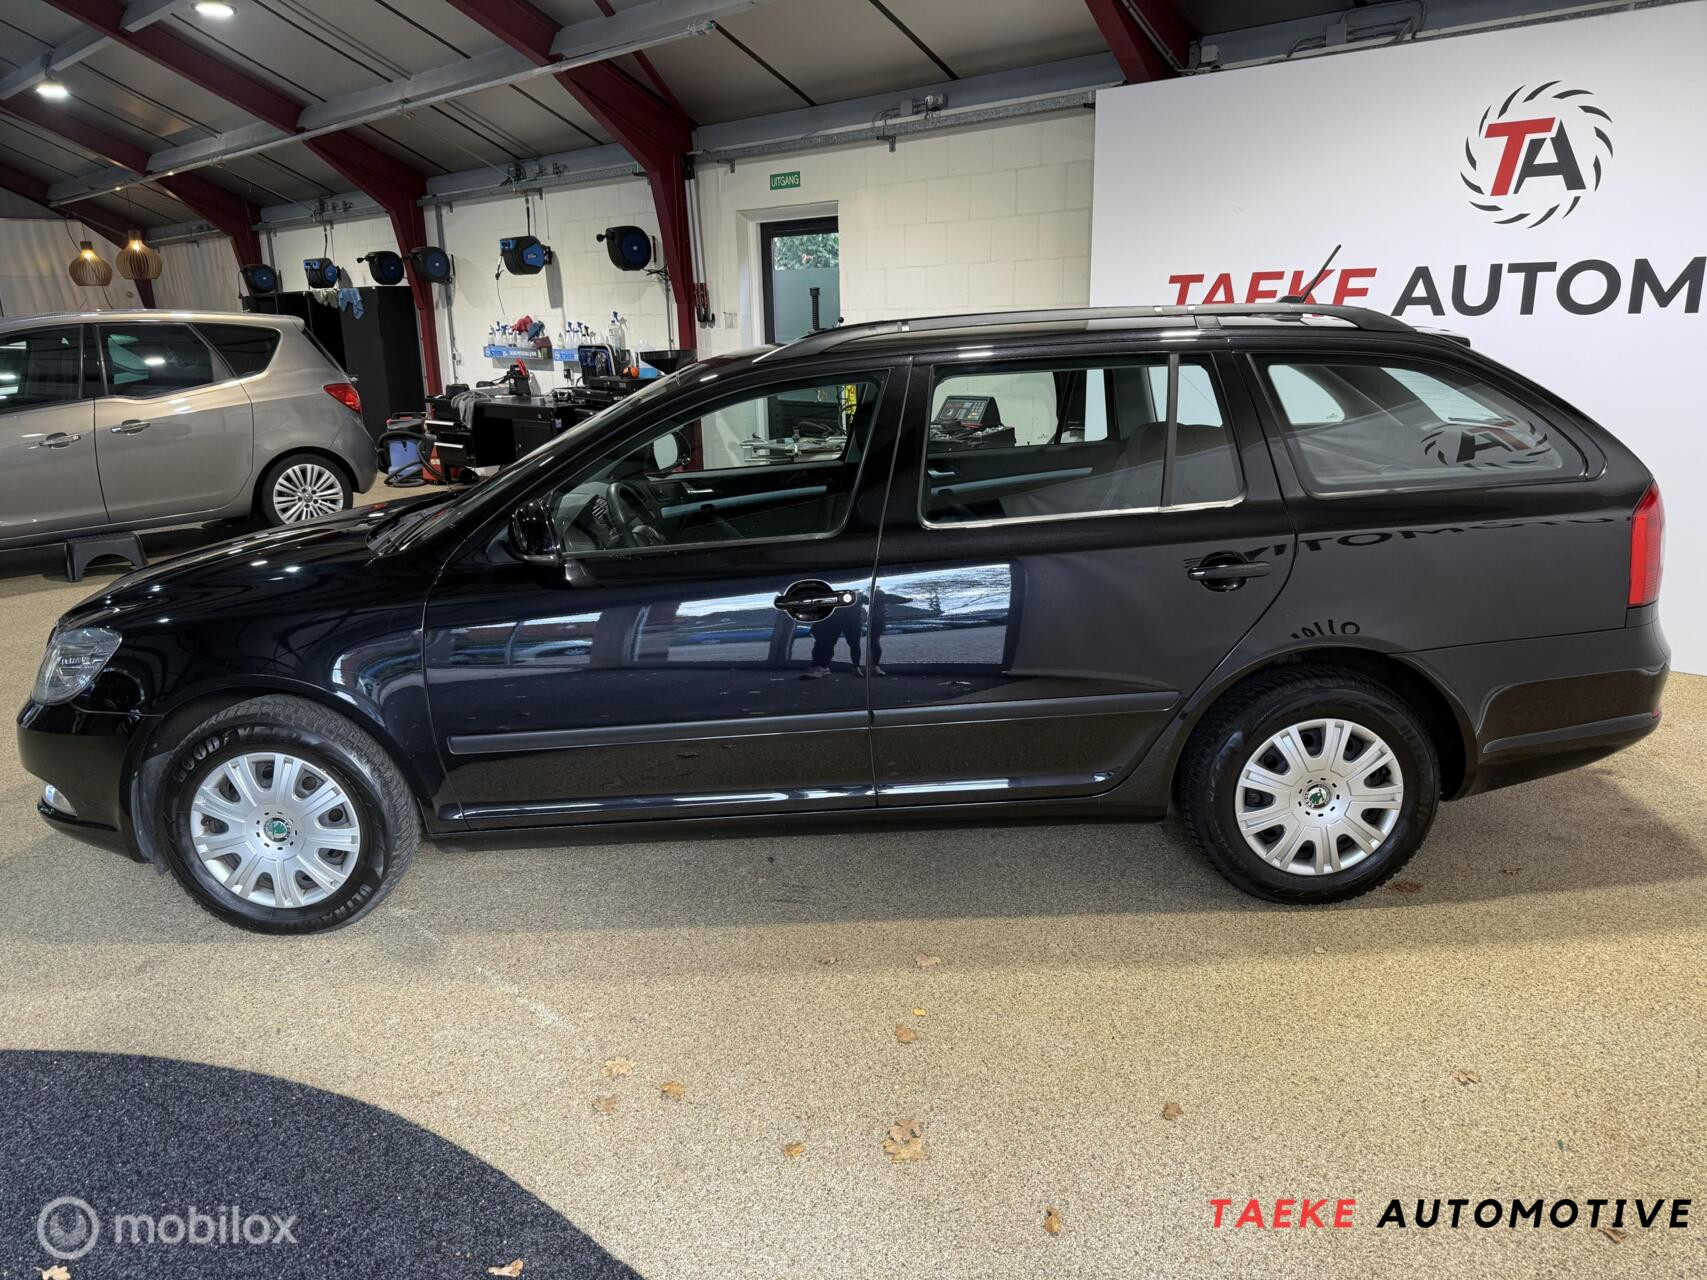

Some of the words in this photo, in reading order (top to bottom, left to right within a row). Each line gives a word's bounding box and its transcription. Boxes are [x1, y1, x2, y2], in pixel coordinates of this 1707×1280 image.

[771, 174, 799, 187] UITGANG
[1485, 118, 1587, 196] TA
[1391, 256, 1707, 317] AUTOM
